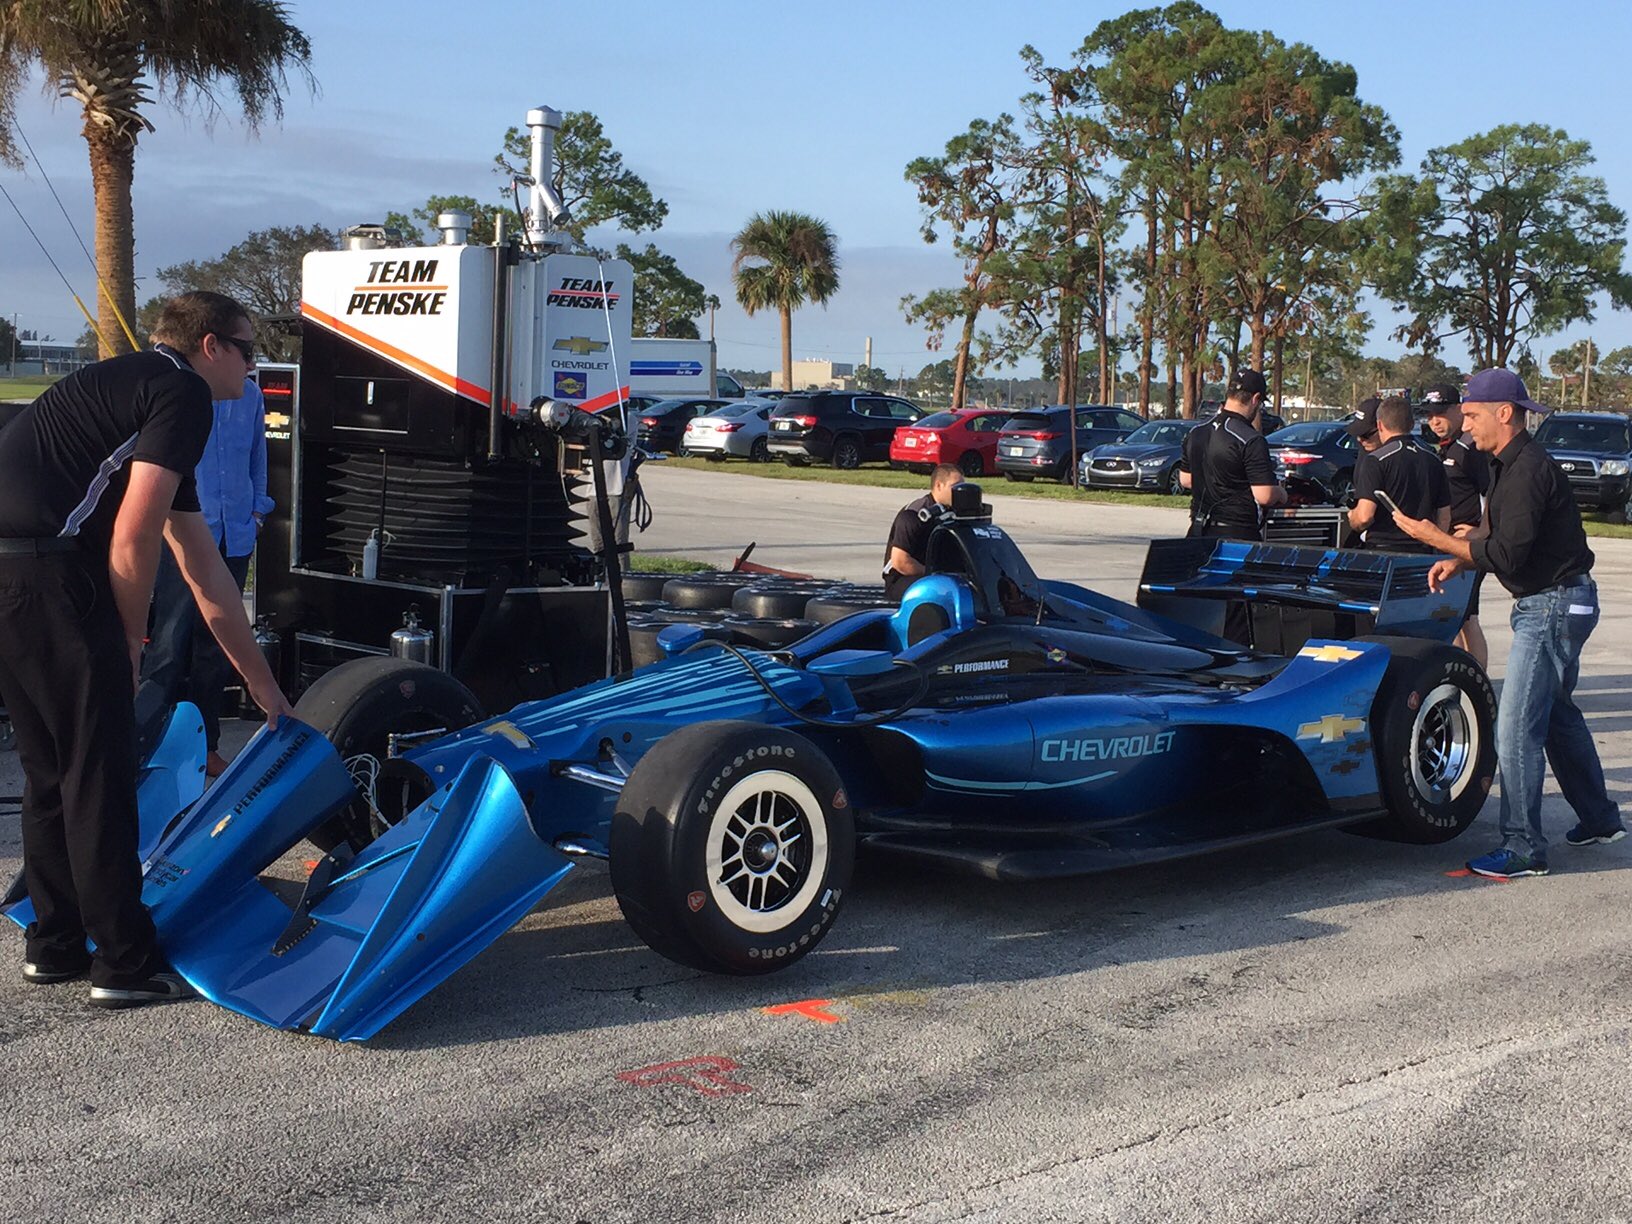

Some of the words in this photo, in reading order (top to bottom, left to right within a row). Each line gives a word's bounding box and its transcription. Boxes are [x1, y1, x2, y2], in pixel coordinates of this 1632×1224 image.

[367, 260, 439, 283] TEAM
[560, 277, 615, 293] TEAM
[346, 292, 447, 315] PENSKE
[546, 294, 619, 311] PENSKE
[551, 360, 610, 370] CHEVROLET
[954, 659, 1010, 673] PERFORMANCE
[1041, 731, 1176, 761] CHEVROLET
[697, 745, 796, 814] Firestone
[749, 888, 842, 959] Firestone
